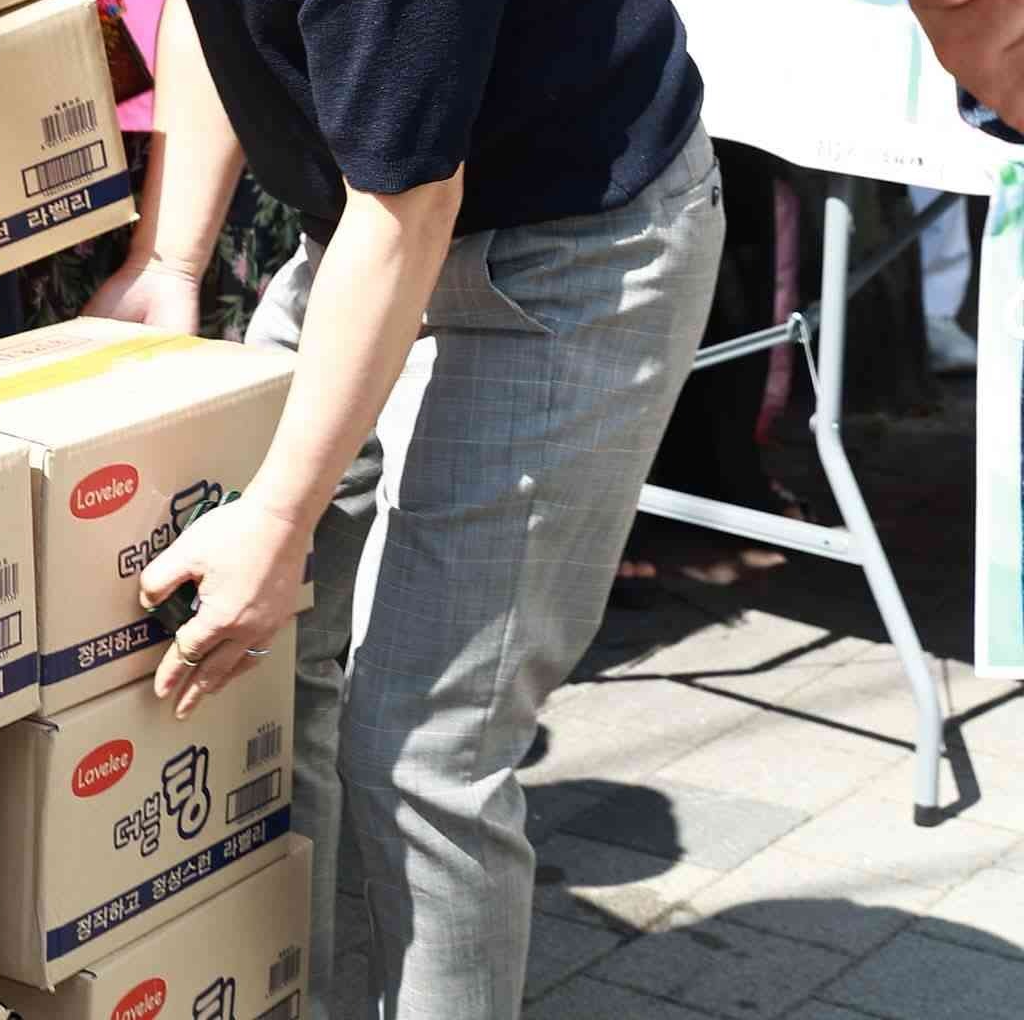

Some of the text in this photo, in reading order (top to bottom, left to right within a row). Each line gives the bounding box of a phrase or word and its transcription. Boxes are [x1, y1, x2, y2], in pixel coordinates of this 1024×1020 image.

[27, 188, 92, 229] 라벨리
[76, 478, 134, 511] Lavelee
[78, 623, 150, 668] 정직하고
[77, 753, 129, 789] Lavelee
[76, 891, 141, 941] 정직하고
[152, 850, 212, 901] 정성스런
